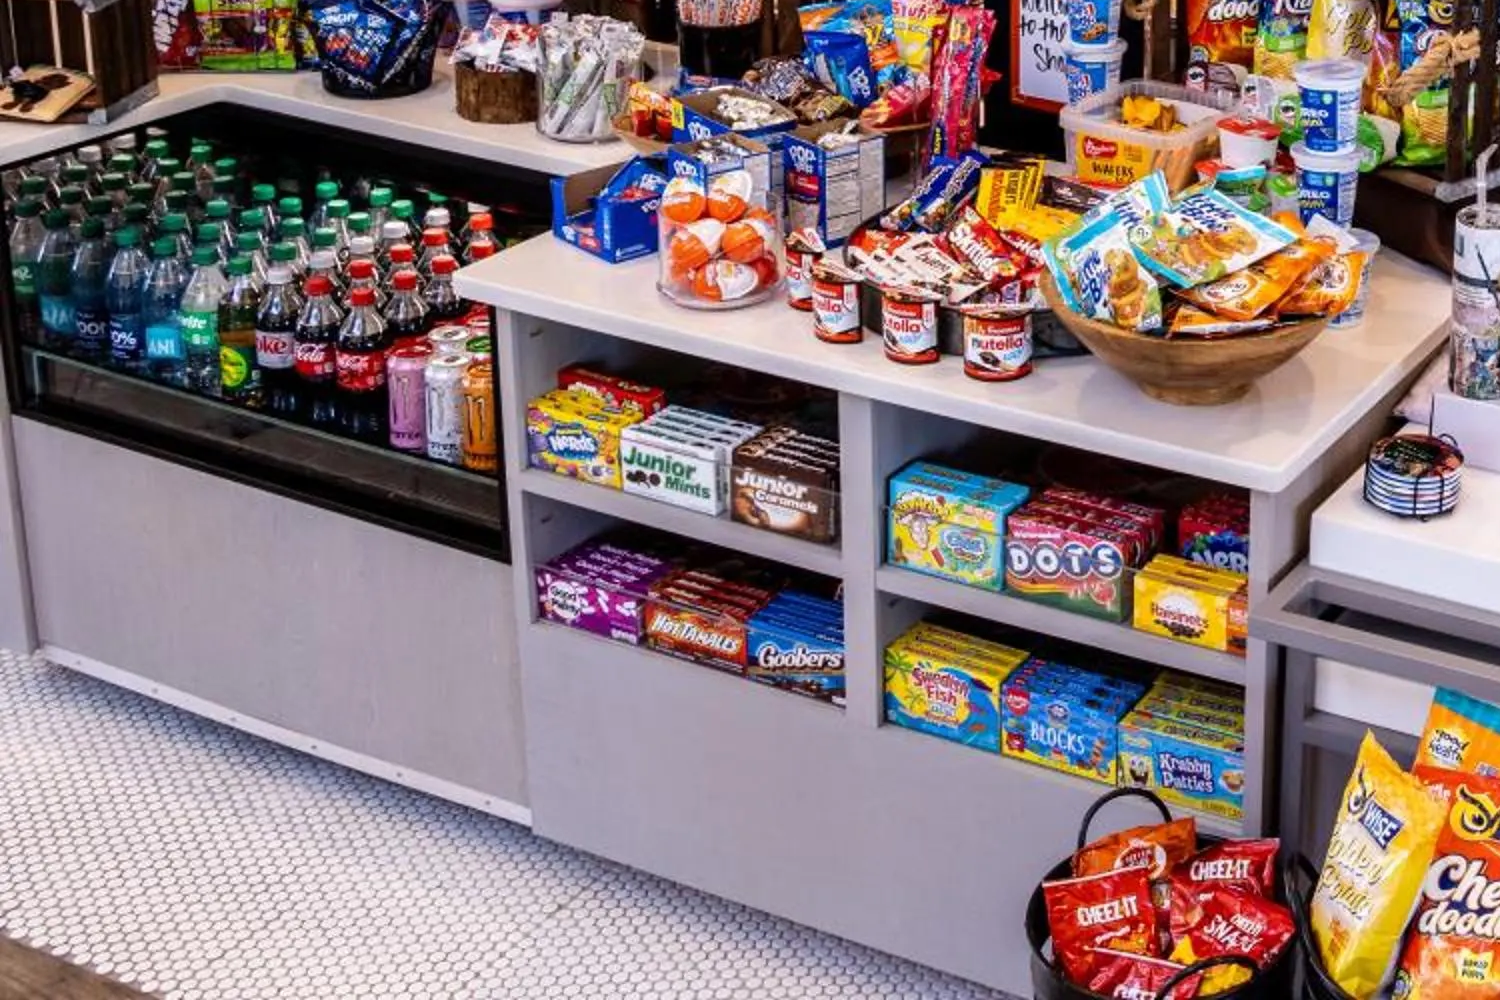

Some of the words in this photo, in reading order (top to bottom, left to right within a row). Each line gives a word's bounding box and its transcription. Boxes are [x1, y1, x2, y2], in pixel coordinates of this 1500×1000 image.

[1020, 14, 1037, 37] to
[1038, 17, 1067, 42] the
[1091, 161, 1135, 178] WAFERS
[972, 333, 1024, 351] nutella
[624, 447, 697, 480] Junior
[664, 475, 711, 499] Mints
[734, 467, 809, 500] Junior
[755, 488, 819, 514] Caramels
[1009, 549, 1117, 575] DOTS
[757, 640, 843, 670] Goobers
[912, 667, 970, 698] Swedish
[926, 684, 958, 707] Fish
[1029, 720, 1087, 756] BLOCKS
[1159, 753, 1213, 780] Krabby
[1162, 771, 1214, 793] Patties
[1363, 804, 1402, 847] WISE
[1189, 858, 1252, 881] CHEEZ-IT
[1076, 894, 1138, 928] CHEEZ-IT
